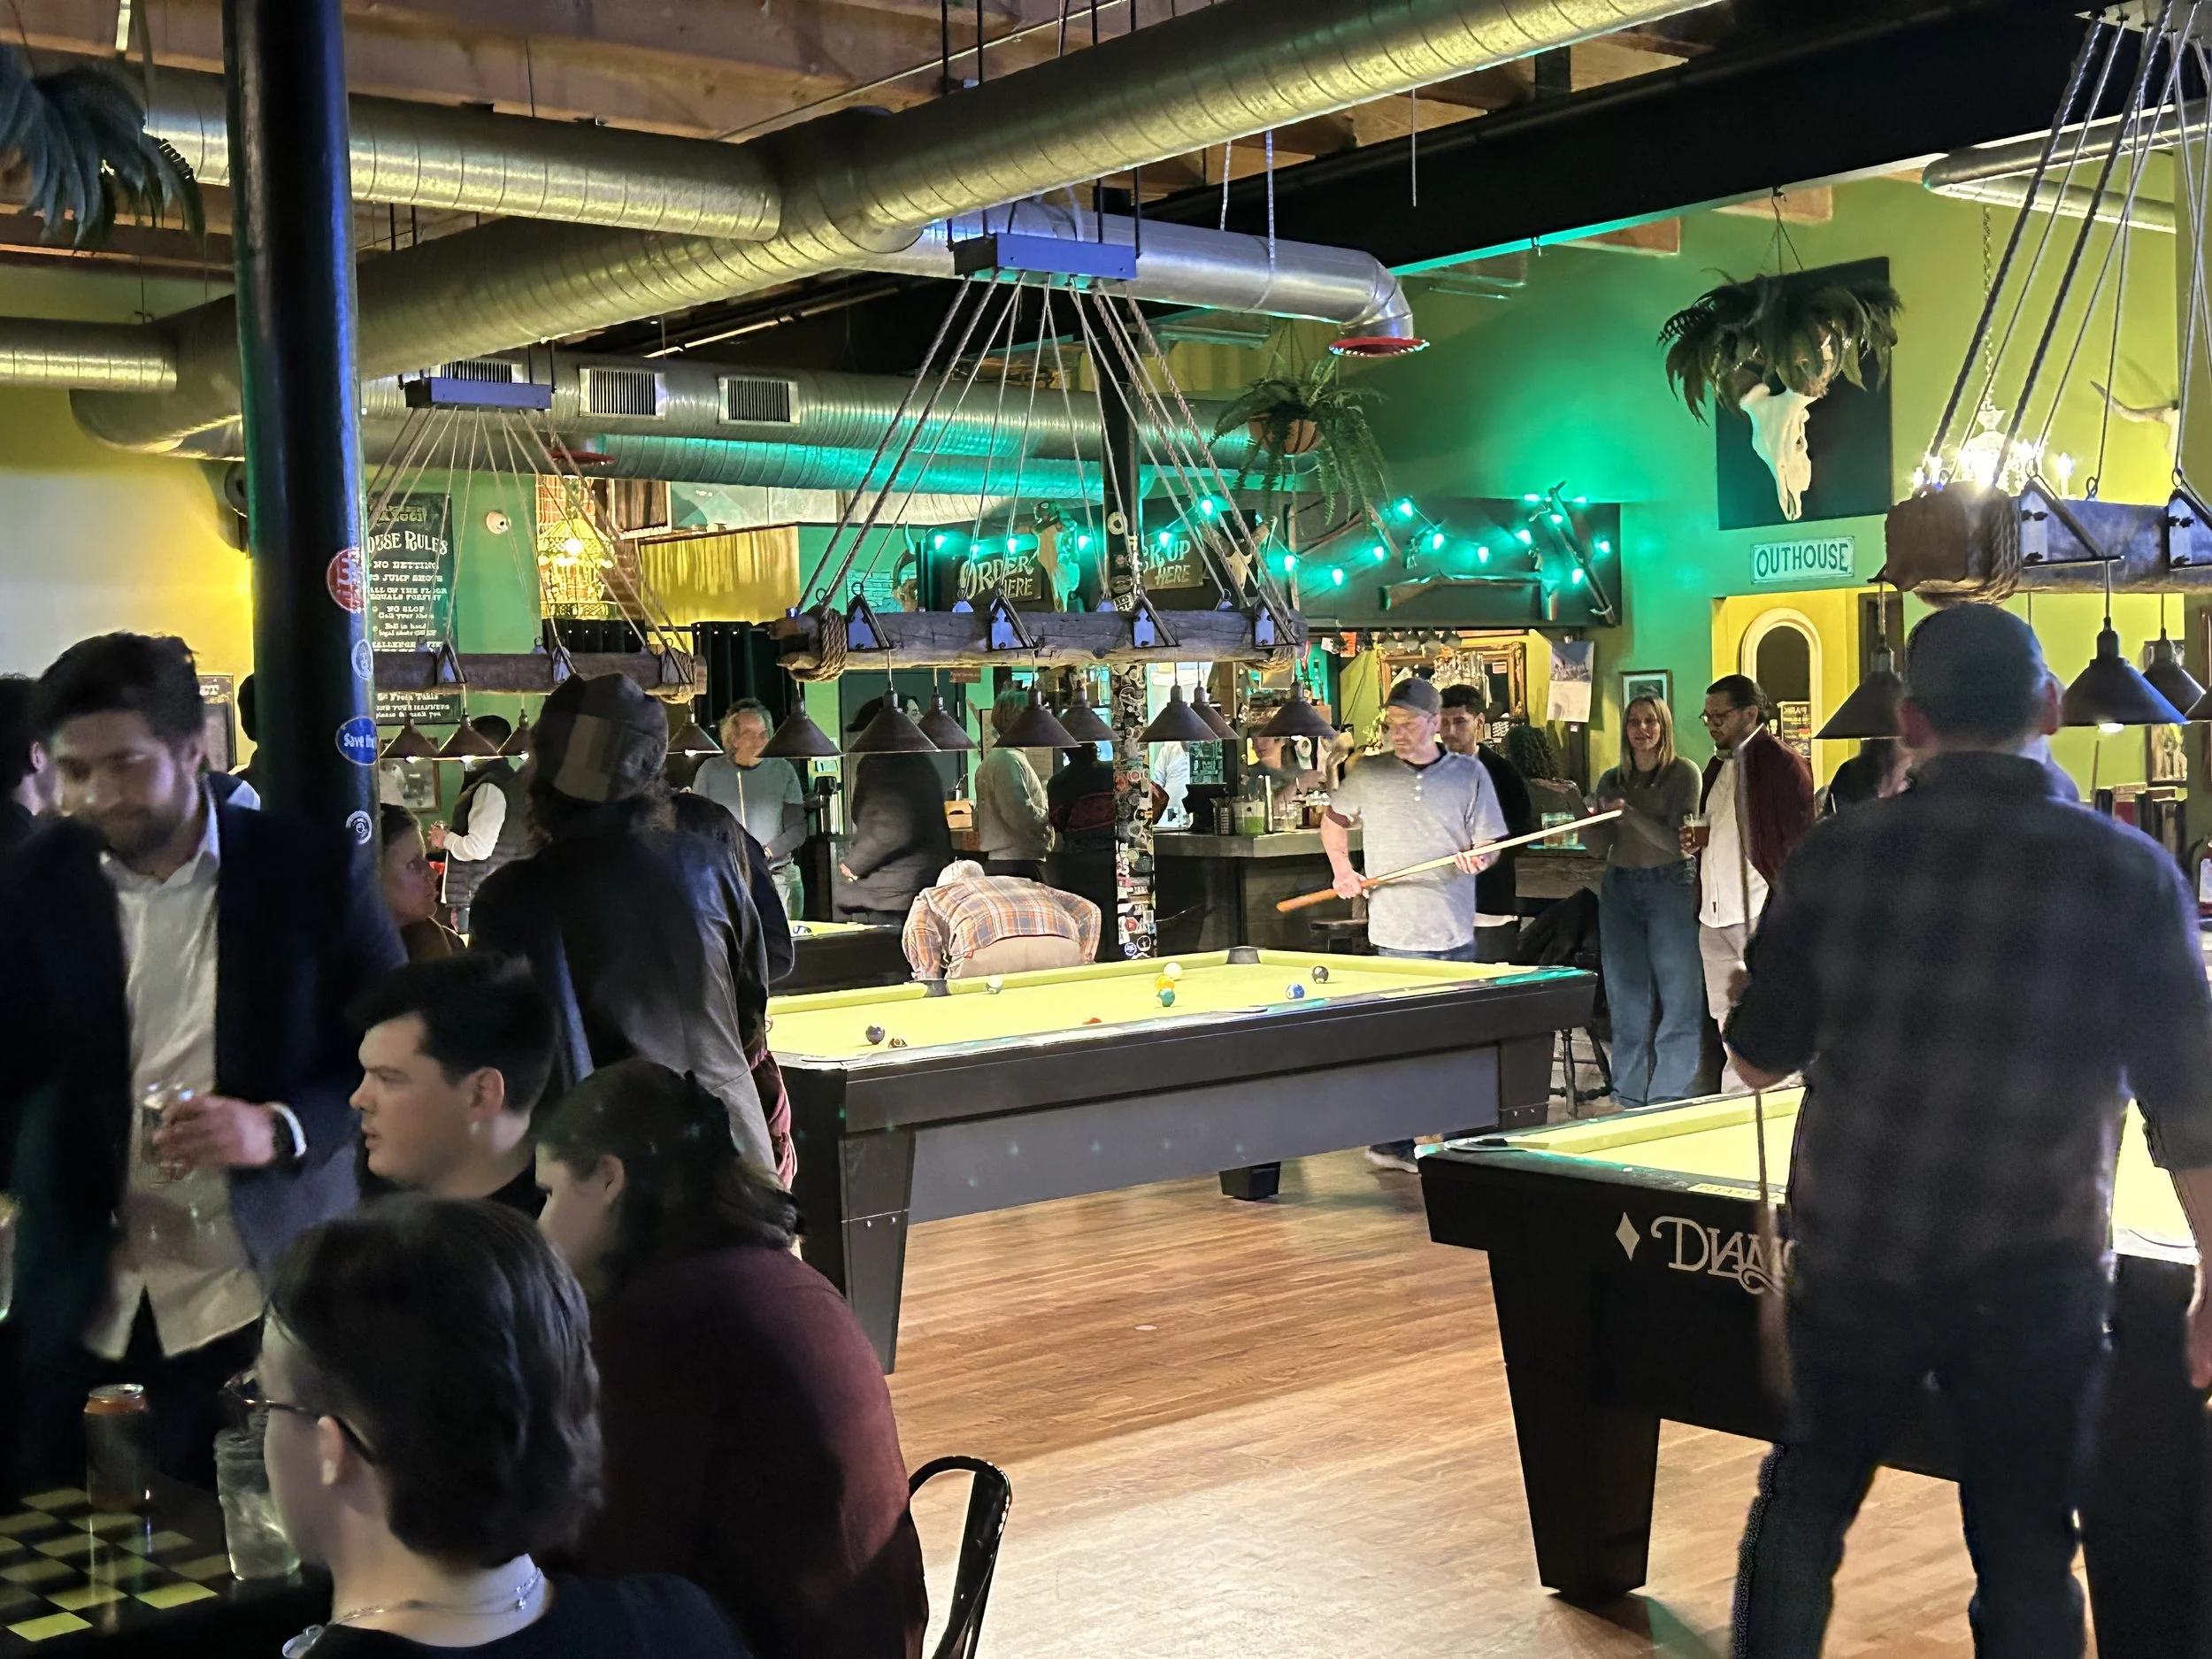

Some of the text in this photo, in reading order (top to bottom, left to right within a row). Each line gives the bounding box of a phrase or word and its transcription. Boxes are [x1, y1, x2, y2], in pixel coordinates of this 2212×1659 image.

[368, 531, 449, 555] OUSE RULES
[1166, 540, 1191, 562] UP
[373, 560, 389, 569] NO
[1756, 542, 1849, 578] OUTHOUSE
[959, 556, 1035, 600] ORDER
[1154, 565, 1191, 586] HERE
[343, 733, 365, 748] Save
